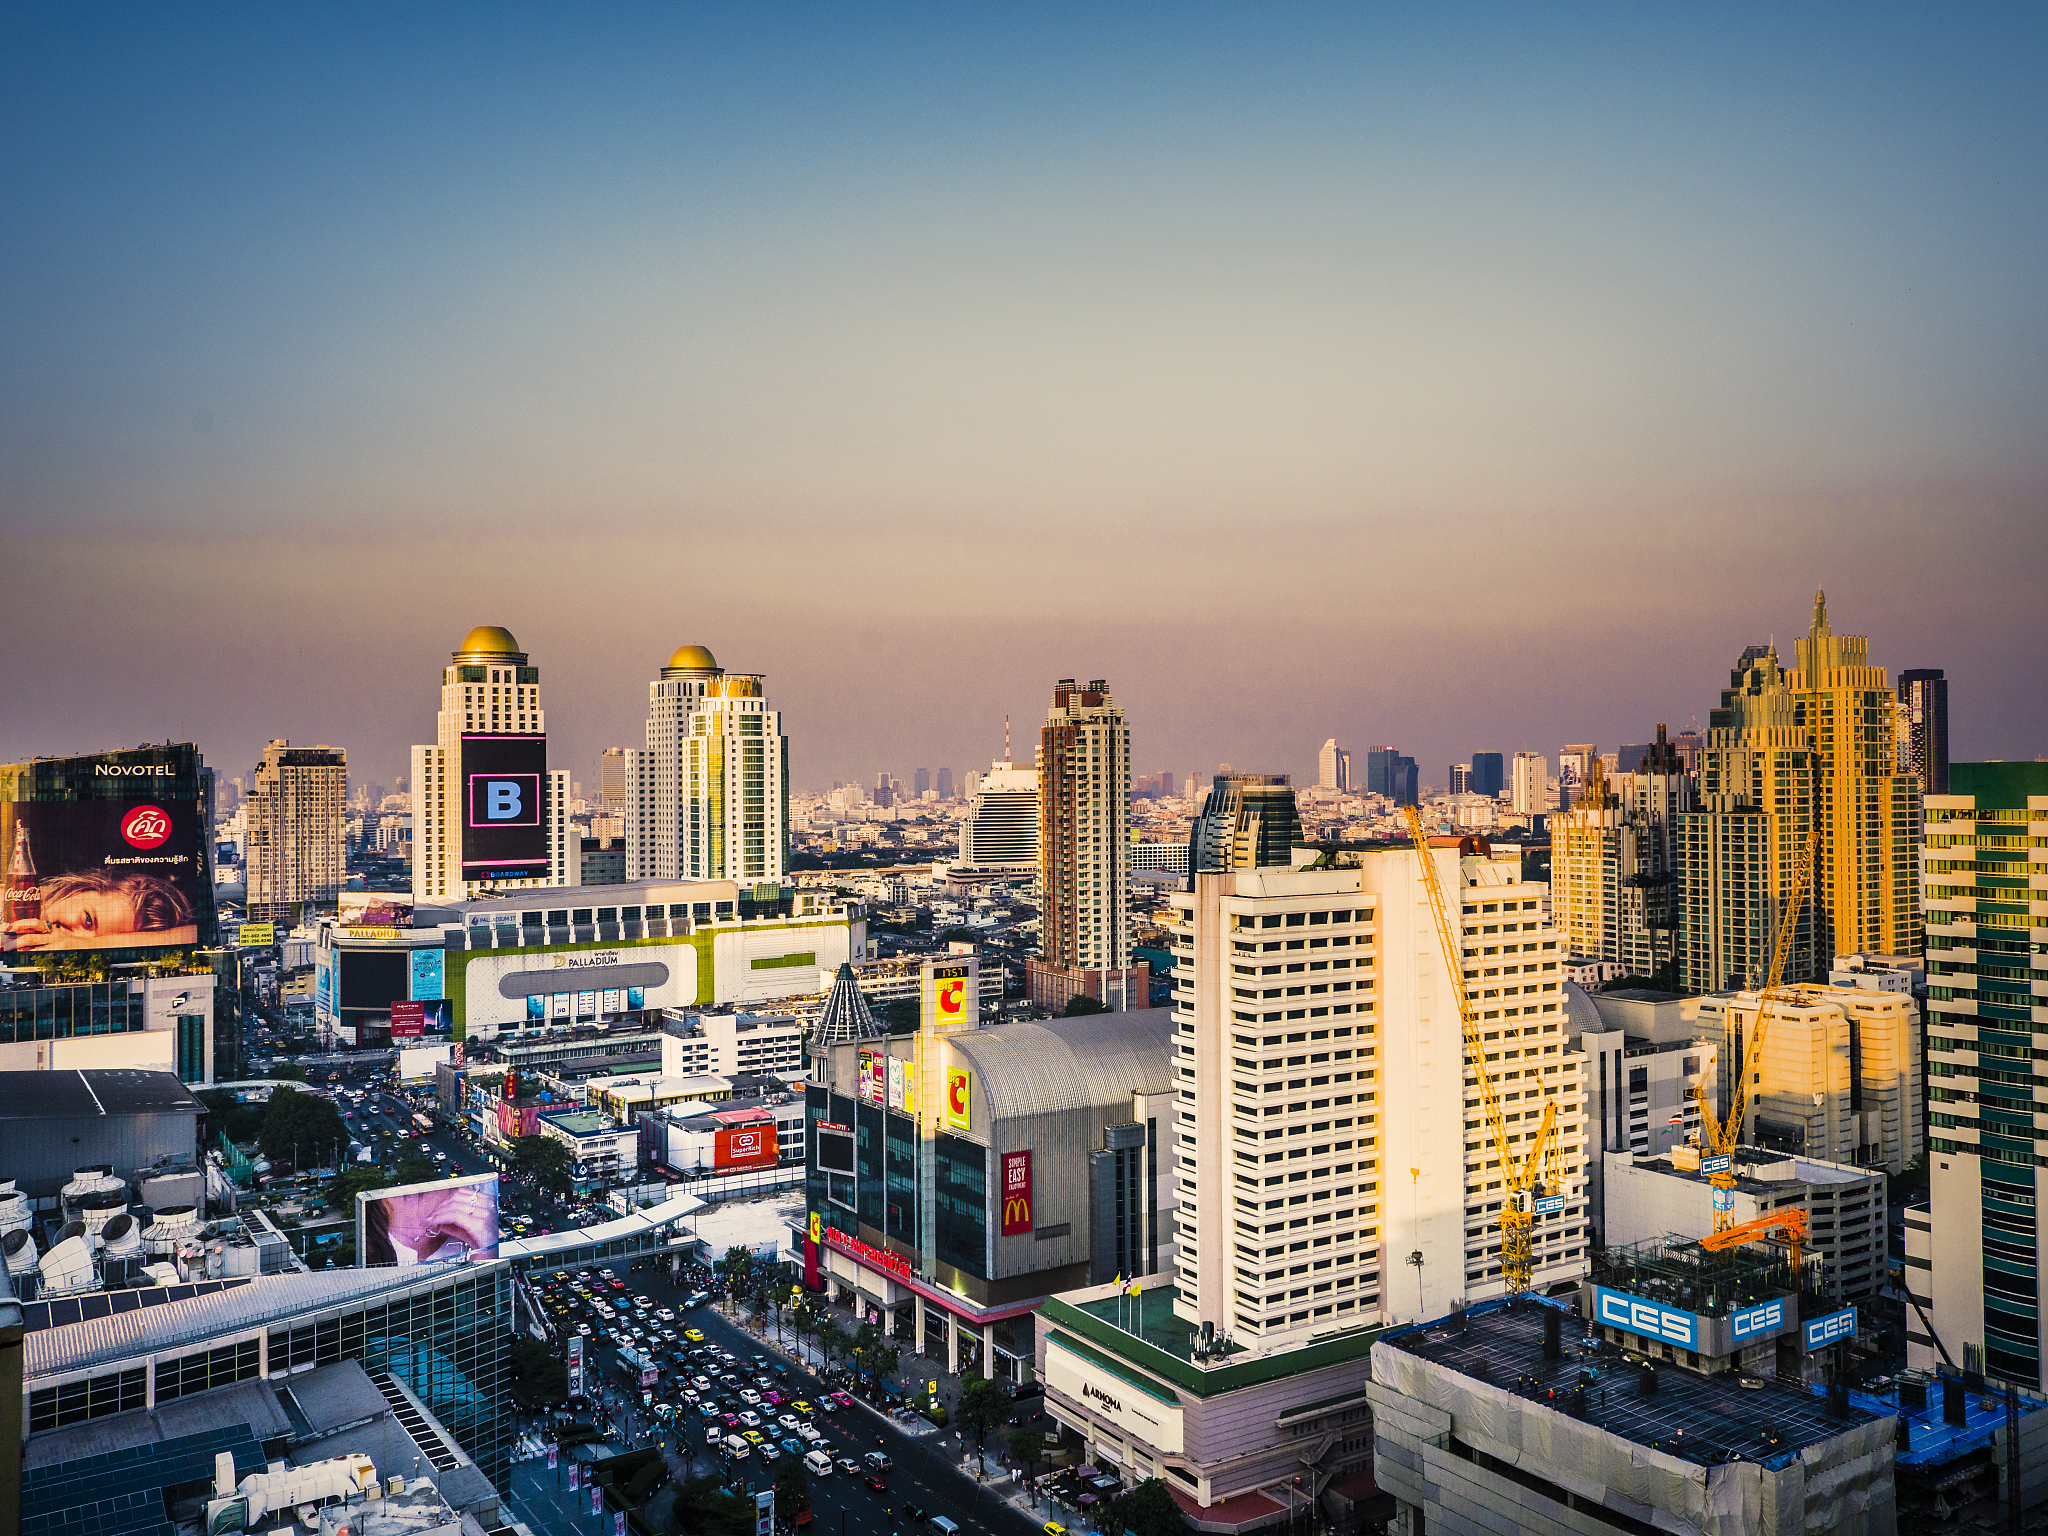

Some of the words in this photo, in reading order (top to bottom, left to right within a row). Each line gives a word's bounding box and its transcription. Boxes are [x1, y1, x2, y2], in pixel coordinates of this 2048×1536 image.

[95, 764, 176, 776] NOVOTEL
[487, 781, 522, 819] B
[349, 930, 402, 938] PALLADIUM
[568, 956, 618, 968] PALLADIUM
[942, 967, 963, 977] 17:57
[940, 981, 964, 1014] C
[950, 1075, 968, 1116] C
[733, 1145, 760, 1154] SuperRich
[1008, 1156, 1026, 1169] SIMPLE
[1702, 1157, 1729, 1175] CES
[1008, 1167, 1026, 1184] EASY
[1536, 1197, 1564, 1213] CES
[827, 1225, 842, 1244] BIG
[842, 1233, 849, 1247] C
[850, 1237, 911, 1280] SUPERCENTER
[1602, 1293, 1691, 1344] CES
[1734, 1303, 1780, 1336] CES
[1808, 1312, 1853, 1344] CES
[1090, 1386, 1123, 1413] ARNOMA
